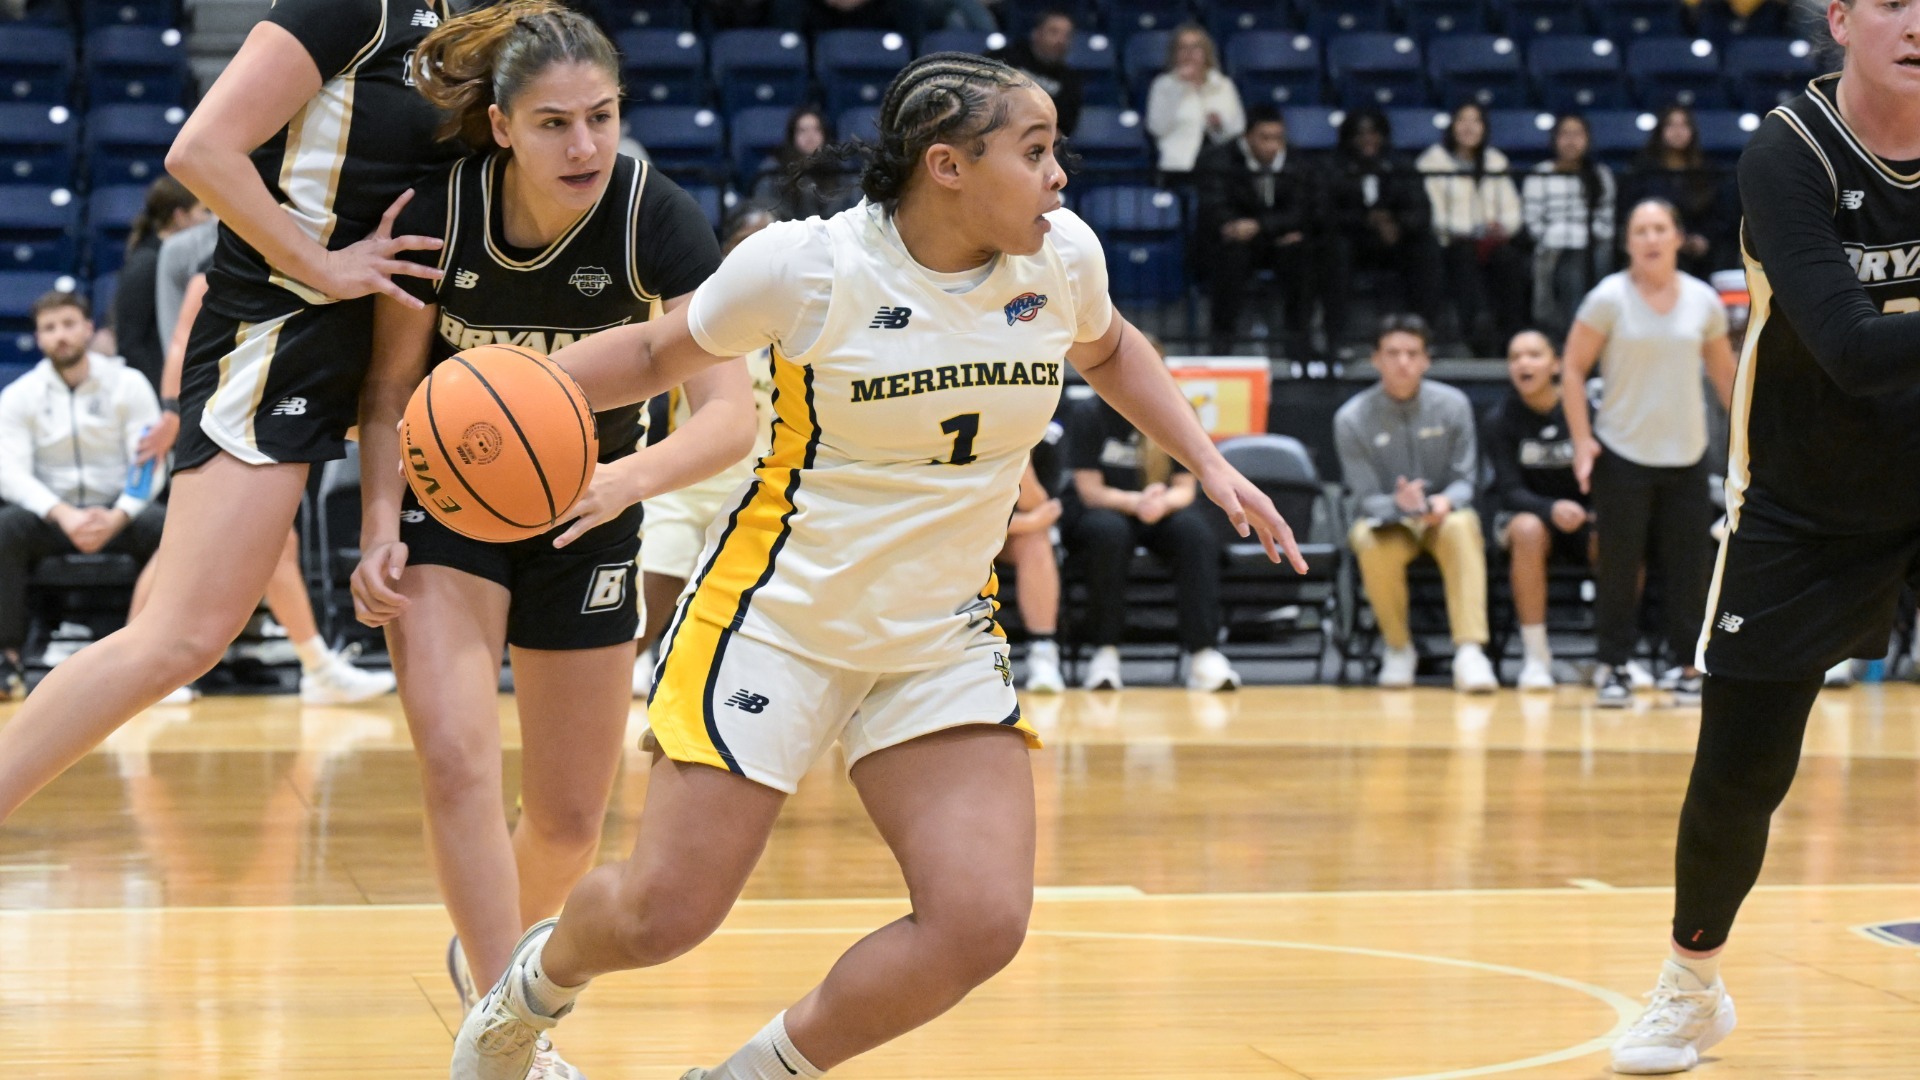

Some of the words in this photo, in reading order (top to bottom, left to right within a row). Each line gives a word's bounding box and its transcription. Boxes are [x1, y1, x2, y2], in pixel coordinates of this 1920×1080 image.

[570, 274, 612, 283] AMERICA
[579, 281, 602, 289] EAST
[869, 306, 912, 329] NB
[1004, 295, 1047, 326] MAAC
[850, 362, 1060, 403] MERRIMACK
[934, 412, 980, 466] 1
[409, 448, 462, 513] EVO
[585, 565, 631, 611] B
[723, 688, 770, 714] NB
